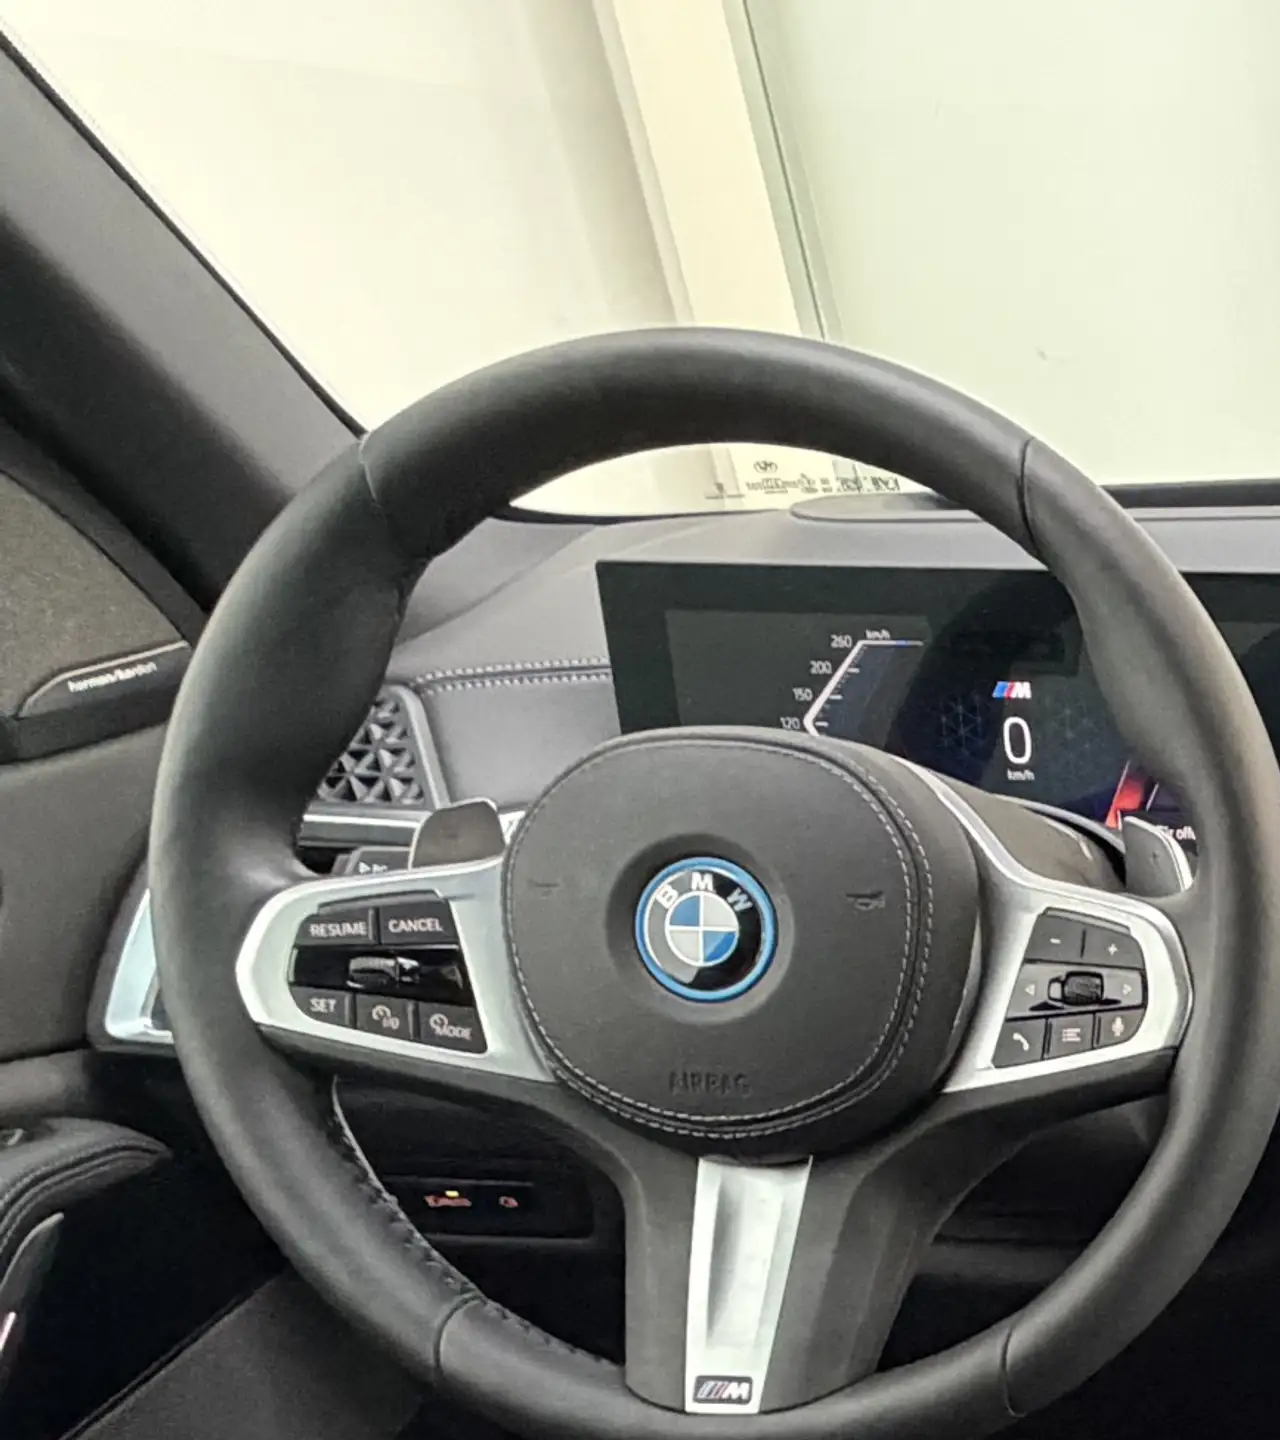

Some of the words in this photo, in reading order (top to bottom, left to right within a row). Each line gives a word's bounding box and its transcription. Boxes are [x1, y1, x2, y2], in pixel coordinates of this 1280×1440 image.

[831, 634, 853, 648] 260
[810, 661, 832, 675] 200
[792, 688, 813, 701] 150
[780, 717, 801, 730] 120
[1003, 715, 1032, 766] 0
[1007, 768, 1035, 782] km/h
[656, 871, 753, 913] BMW
[309, 921, 368, 938] RESUME
[388, 917, 444, 934] CANCEL
[309, 997, 338, 1014] SET
[434, 1023, 473, 1041] MODE
